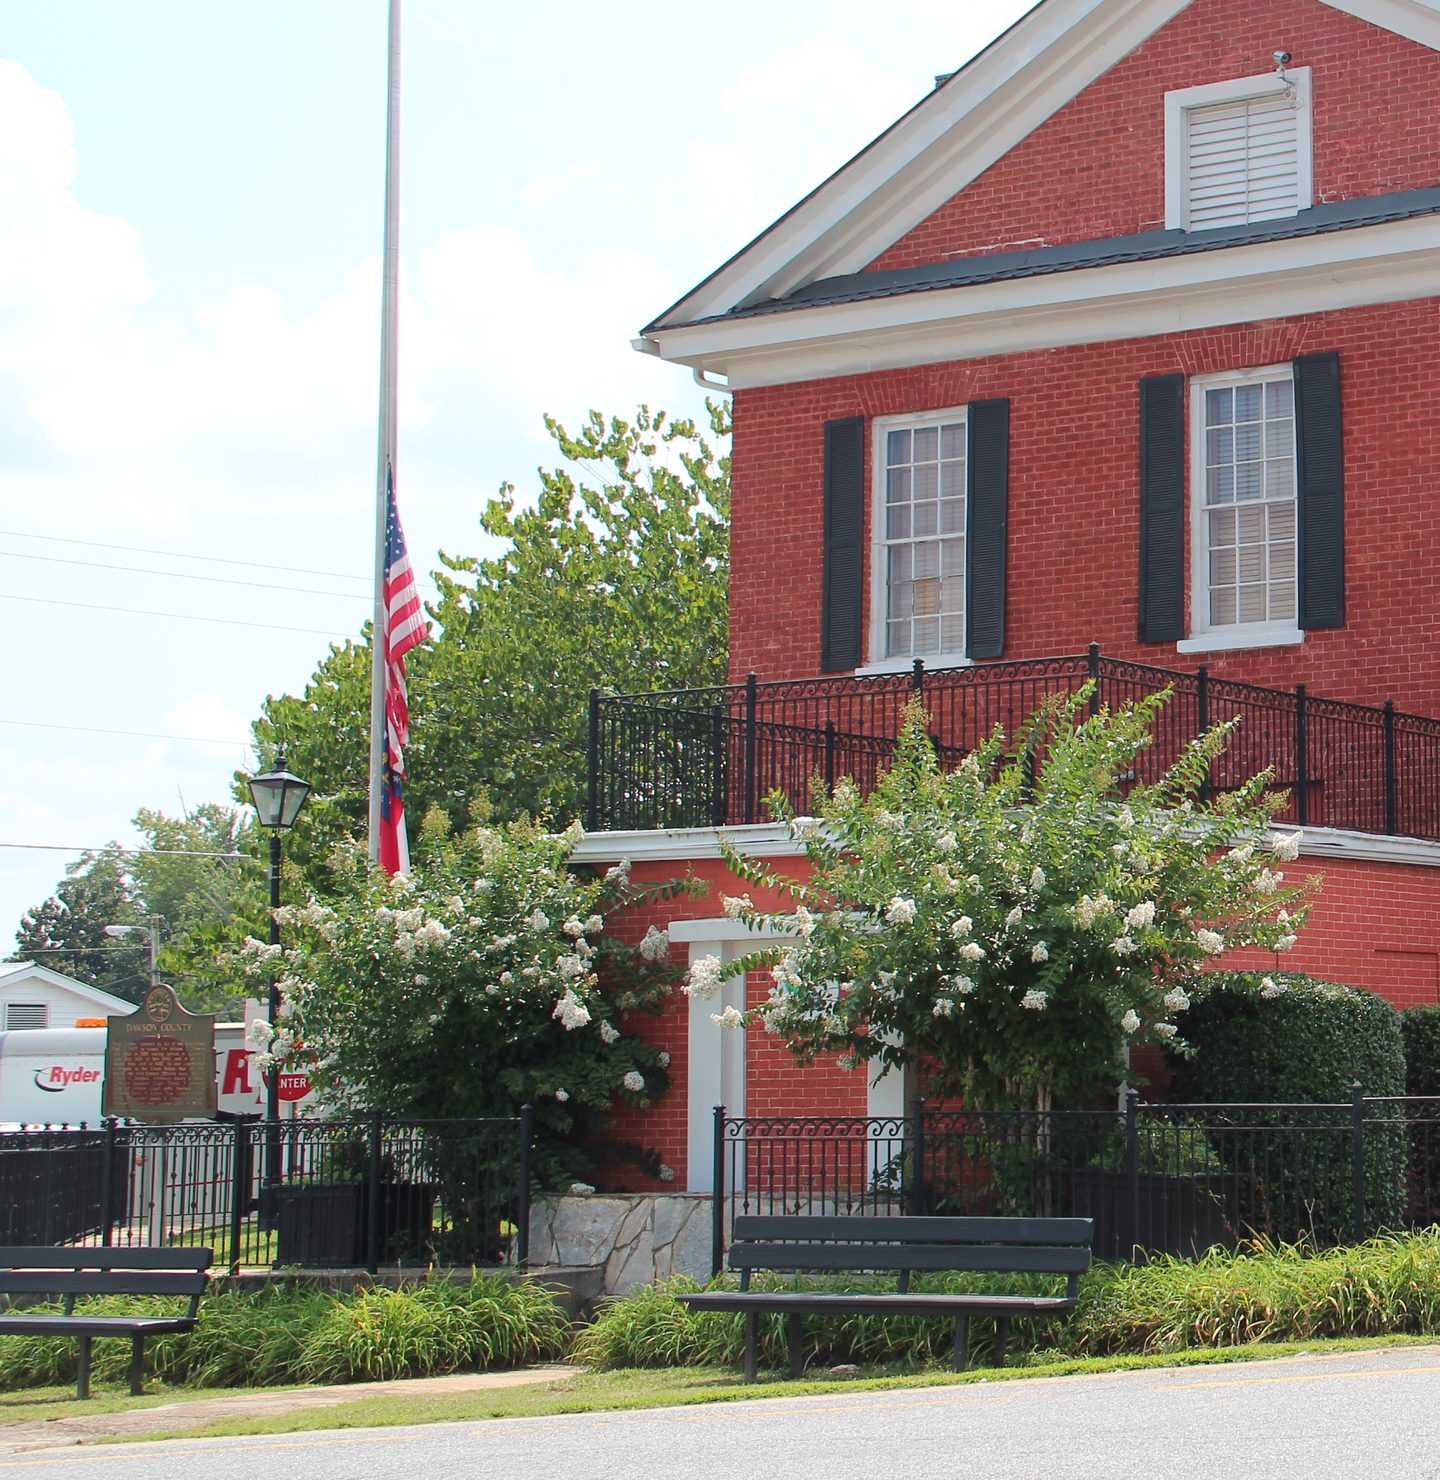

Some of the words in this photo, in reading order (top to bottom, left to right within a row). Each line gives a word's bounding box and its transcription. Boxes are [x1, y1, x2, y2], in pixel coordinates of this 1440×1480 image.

[126, 1023, 158, 1032] DAWSON
[160, 1023, 193, 1032] COUNTY
[49, 1066, 101, 1086] Ryder
[279, 1078, 306, 1089] NTER
